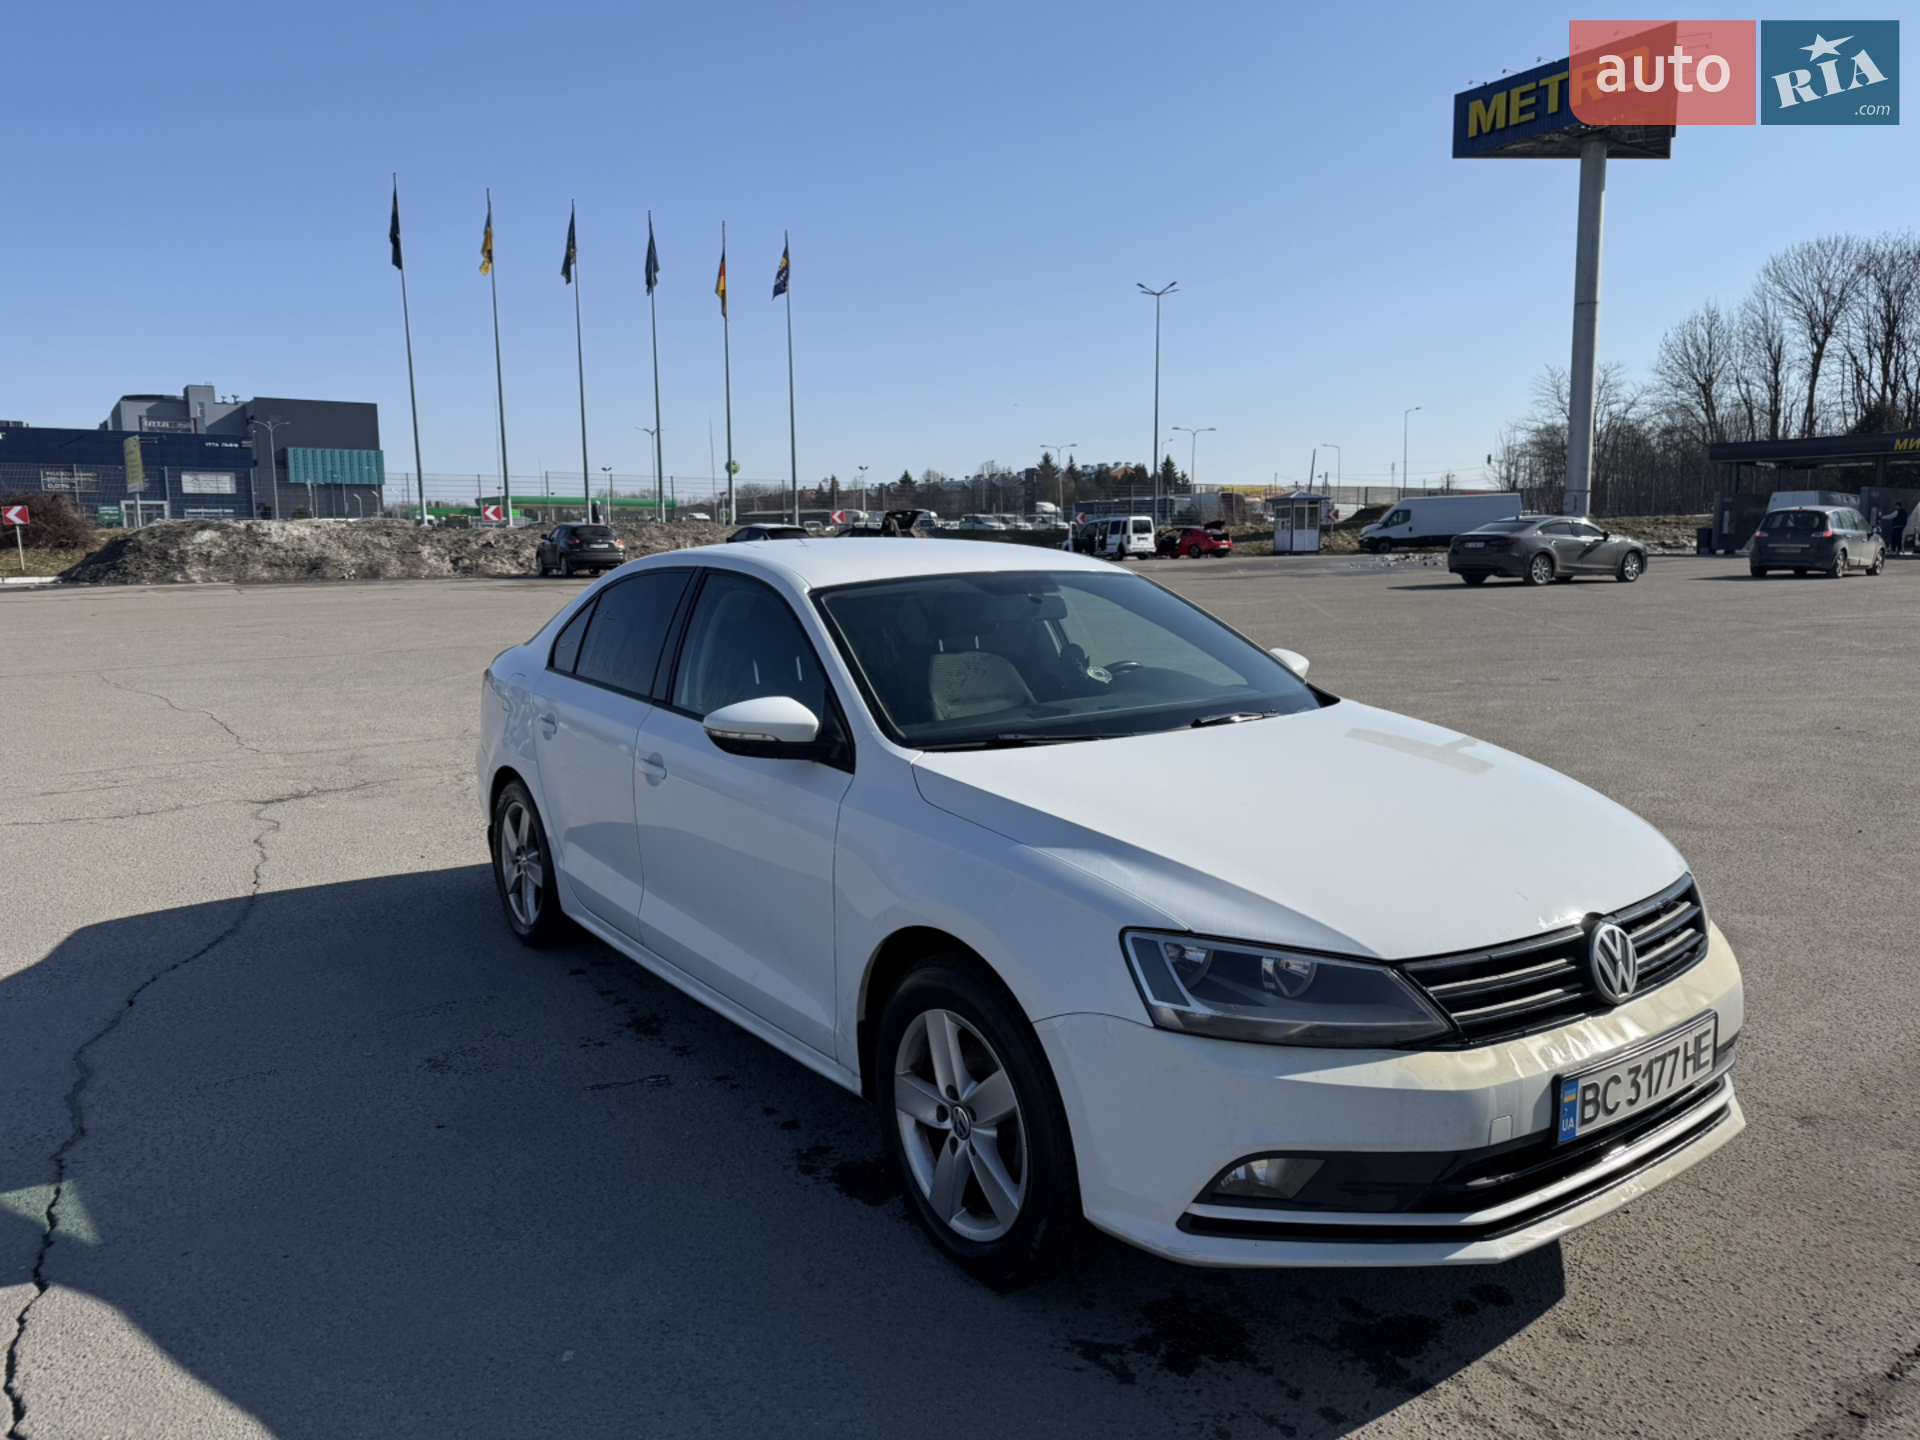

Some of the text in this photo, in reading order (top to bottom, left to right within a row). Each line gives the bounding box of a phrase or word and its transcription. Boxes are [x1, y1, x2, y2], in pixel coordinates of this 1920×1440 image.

[1467, 45, 1651, 139] METRO
[1561, 1116, 1575, 1132] UA
[1580, 1027, 1712, 1127] BC 3177 HE
